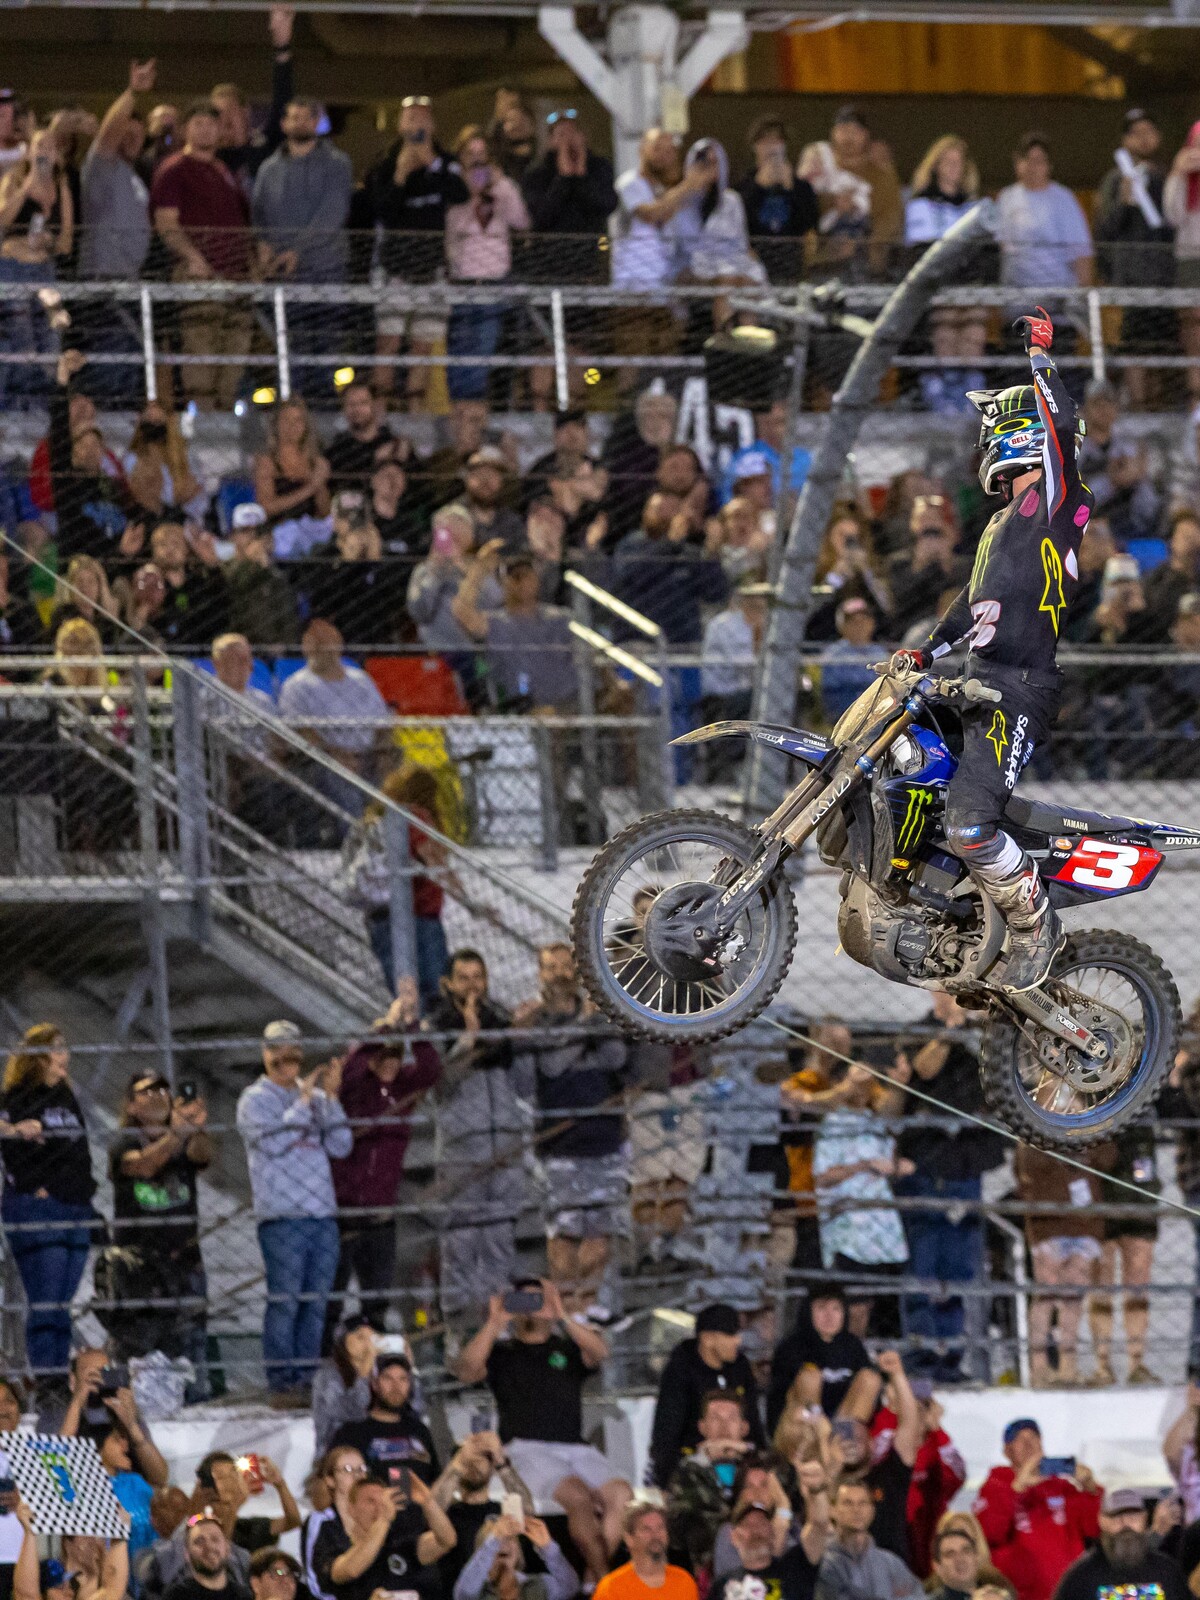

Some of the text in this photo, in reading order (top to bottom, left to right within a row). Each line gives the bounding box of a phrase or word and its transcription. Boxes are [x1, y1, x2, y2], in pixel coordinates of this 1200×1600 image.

[1011, 435, 1030, 445] BELL
[1062, 818, 1089, 831] YAMAHA
[1071, 839, 1141, 889] 3
[1024, 990, 1055, 1014] YAMALUBE
